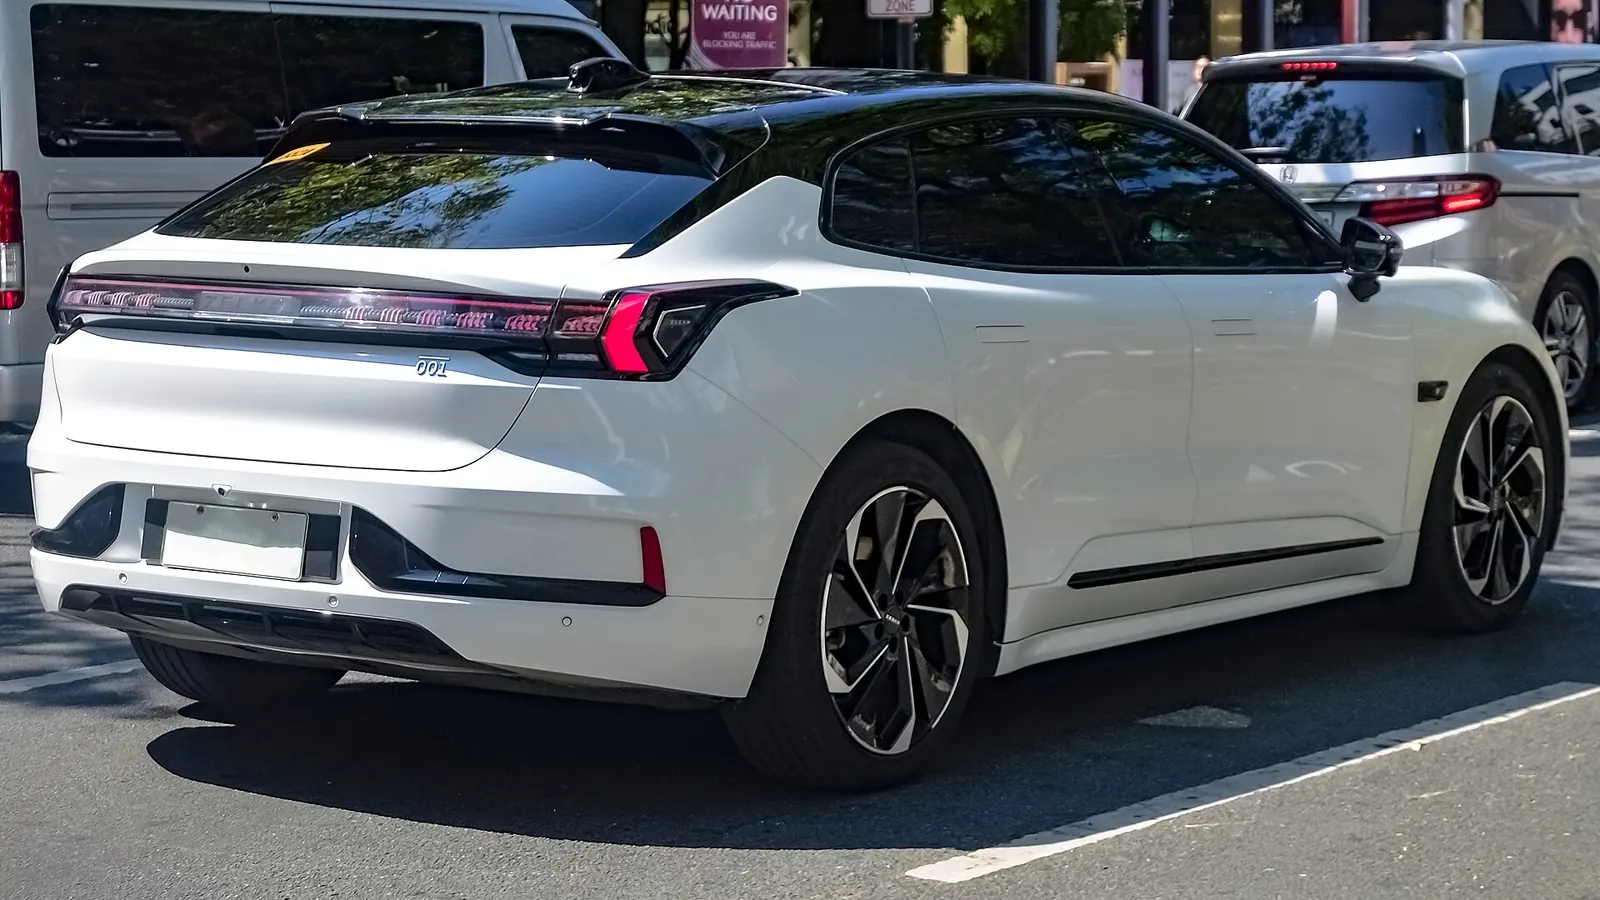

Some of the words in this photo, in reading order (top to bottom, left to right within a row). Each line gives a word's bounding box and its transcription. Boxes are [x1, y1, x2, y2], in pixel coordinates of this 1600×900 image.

[885, 0, 915, 11] ZONE
[702, 4, 778, 21] WAITING
[723, 31, 740, 39] YOU
[741, 31, 757, 39] ARE
[703, 40, 744, 48] BLOCKING
[746, 41, 777, 49] TRAFFIC
[416, 359, 448, 377] 001
